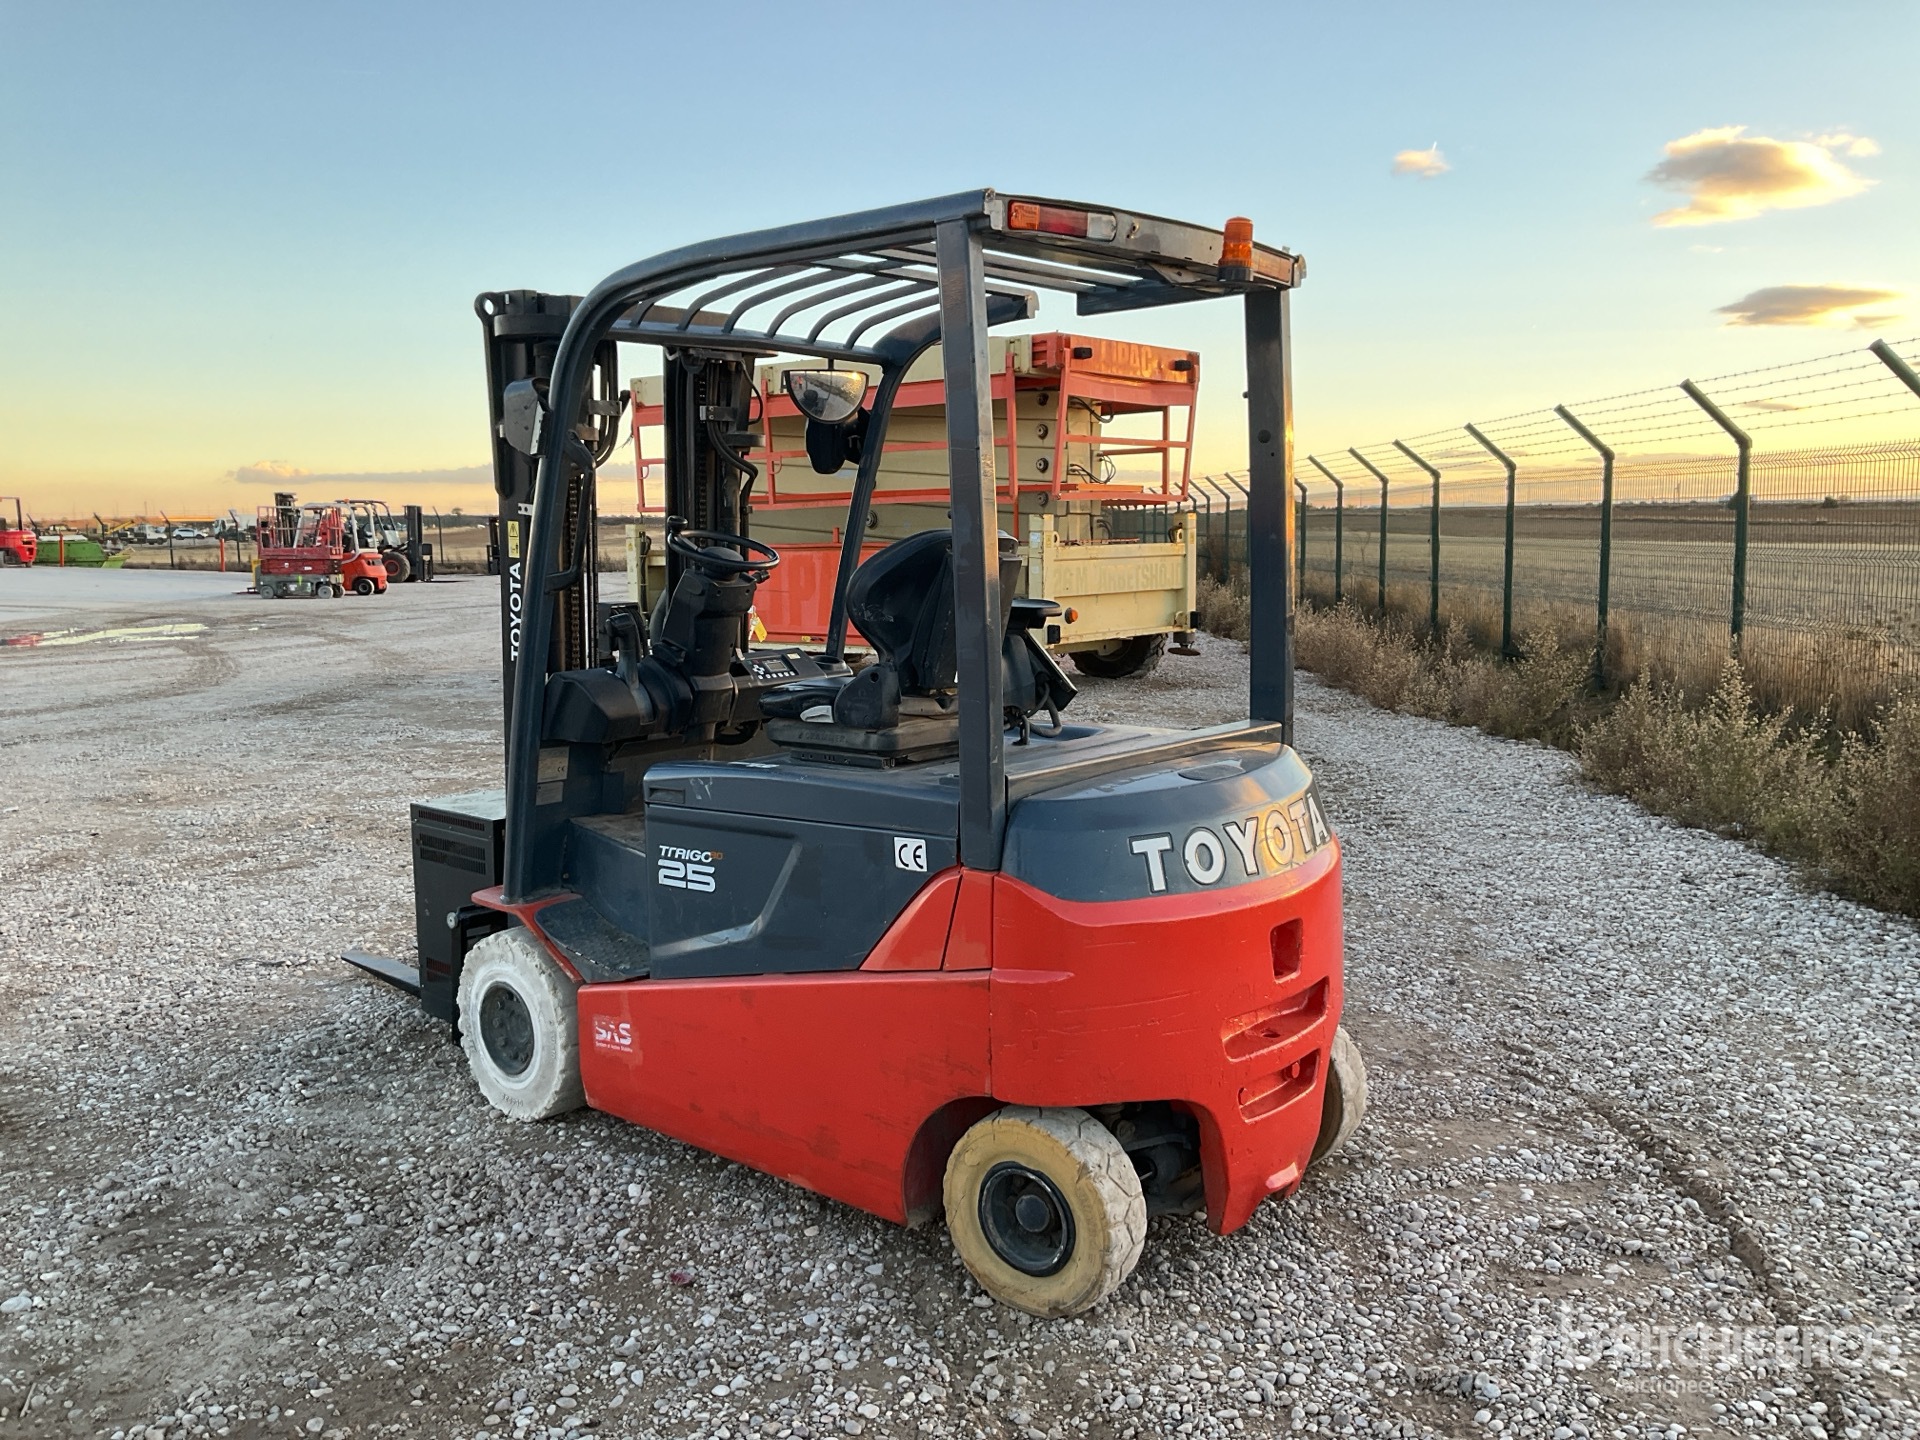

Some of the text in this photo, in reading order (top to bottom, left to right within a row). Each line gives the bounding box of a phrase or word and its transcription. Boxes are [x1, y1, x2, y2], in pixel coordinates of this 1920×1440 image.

[509, 561, 521, 662] TOYOTA
[658, 858, 716, 893] 25
[898, 843, 924, 870] CE
[1130, 792, 1330, 892] TOYOTA
